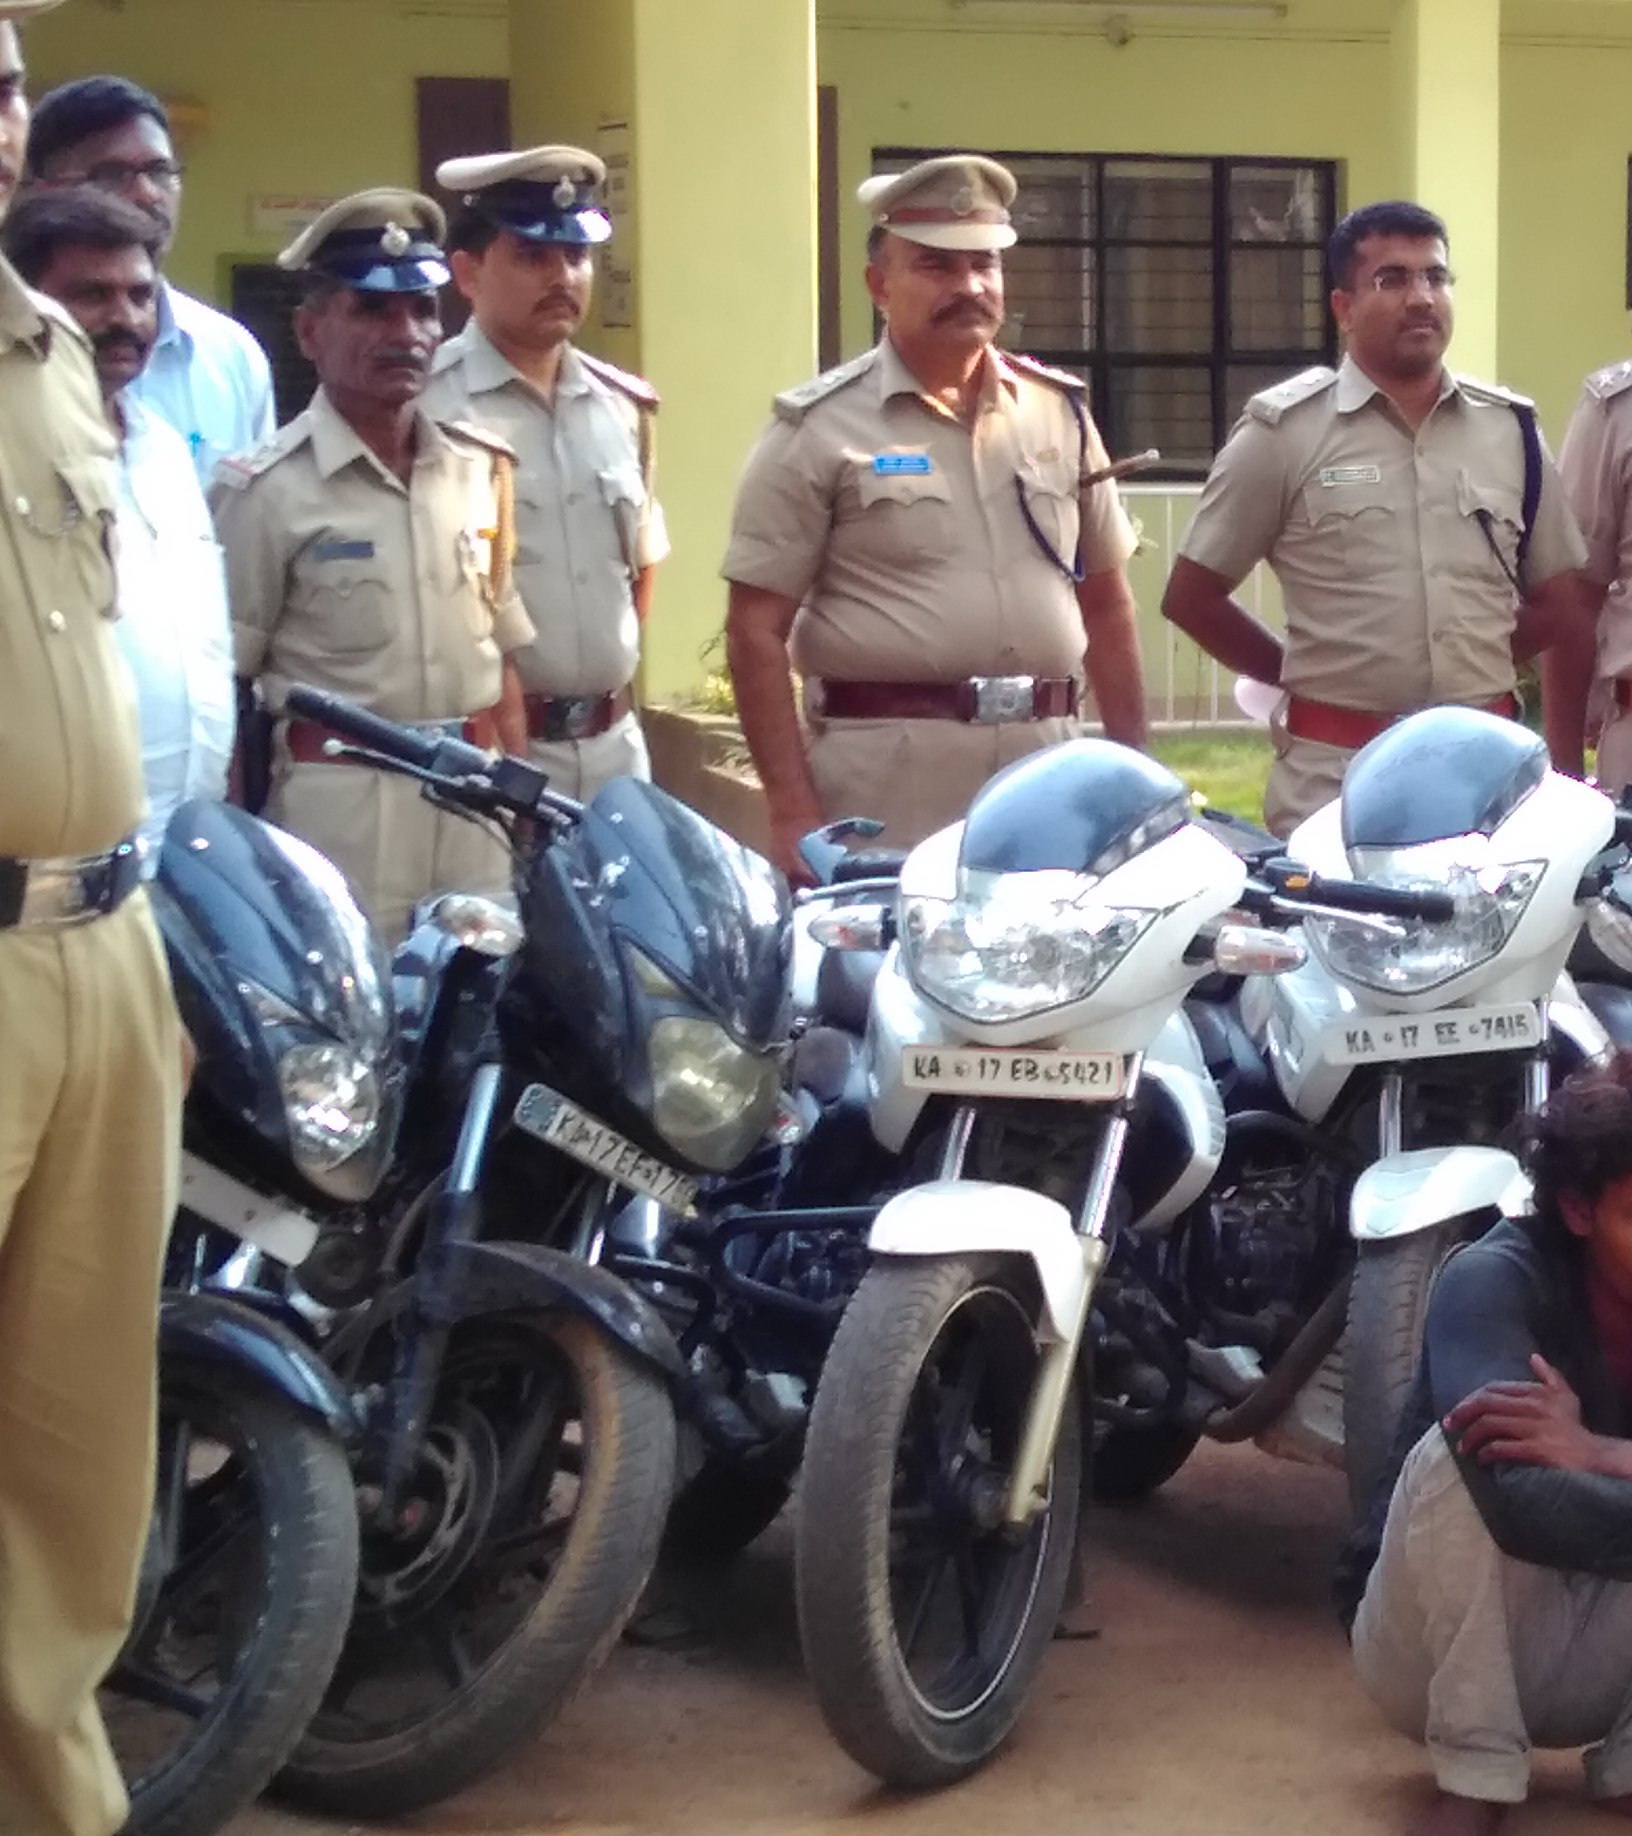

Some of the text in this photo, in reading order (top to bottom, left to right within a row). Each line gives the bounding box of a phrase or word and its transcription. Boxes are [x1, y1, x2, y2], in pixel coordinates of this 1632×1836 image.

[1345, 1030, 1376, 1054] KA
[1400, 1024, 1419, 1048] 17
[914, 1055, 941, 1079] KA
[979, 1057, 1001, 1080] 17
[1011, 1058, 1040, 1082] EB
